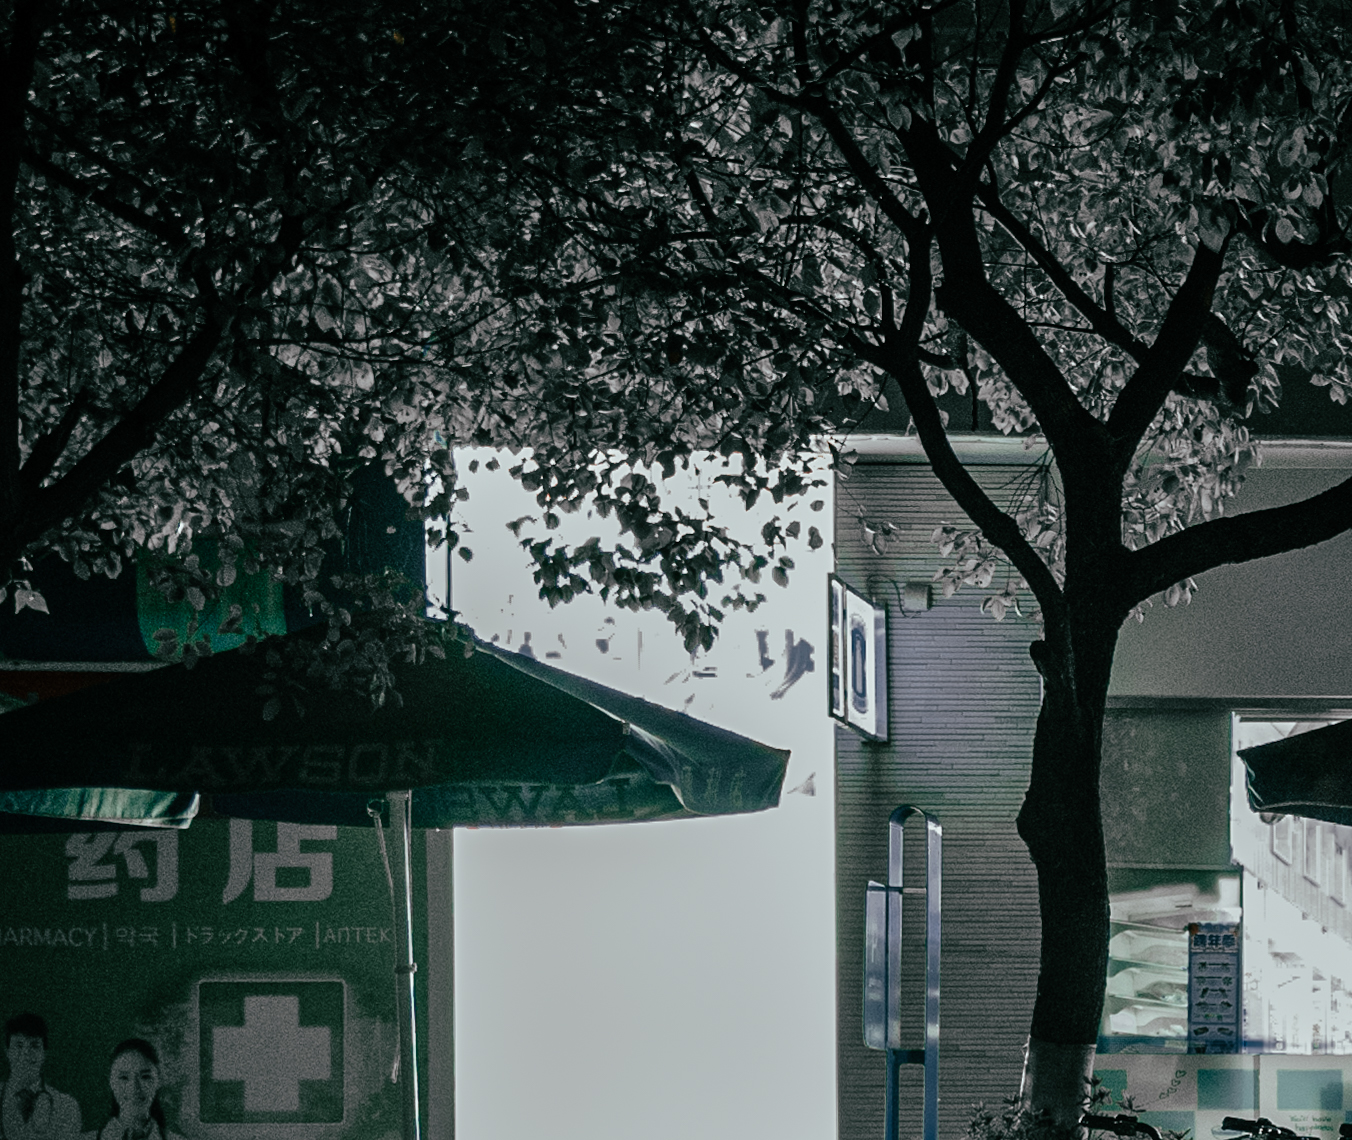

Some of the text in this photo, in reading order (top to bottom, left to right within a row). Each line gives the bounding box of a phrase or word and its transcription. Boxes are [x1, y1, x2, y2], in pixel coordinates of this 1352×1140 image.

[124, 740, 438, 785] LAWSON
[0, 926, 97, 948] ARMACY
[115, 926, 159, 948] 약국
